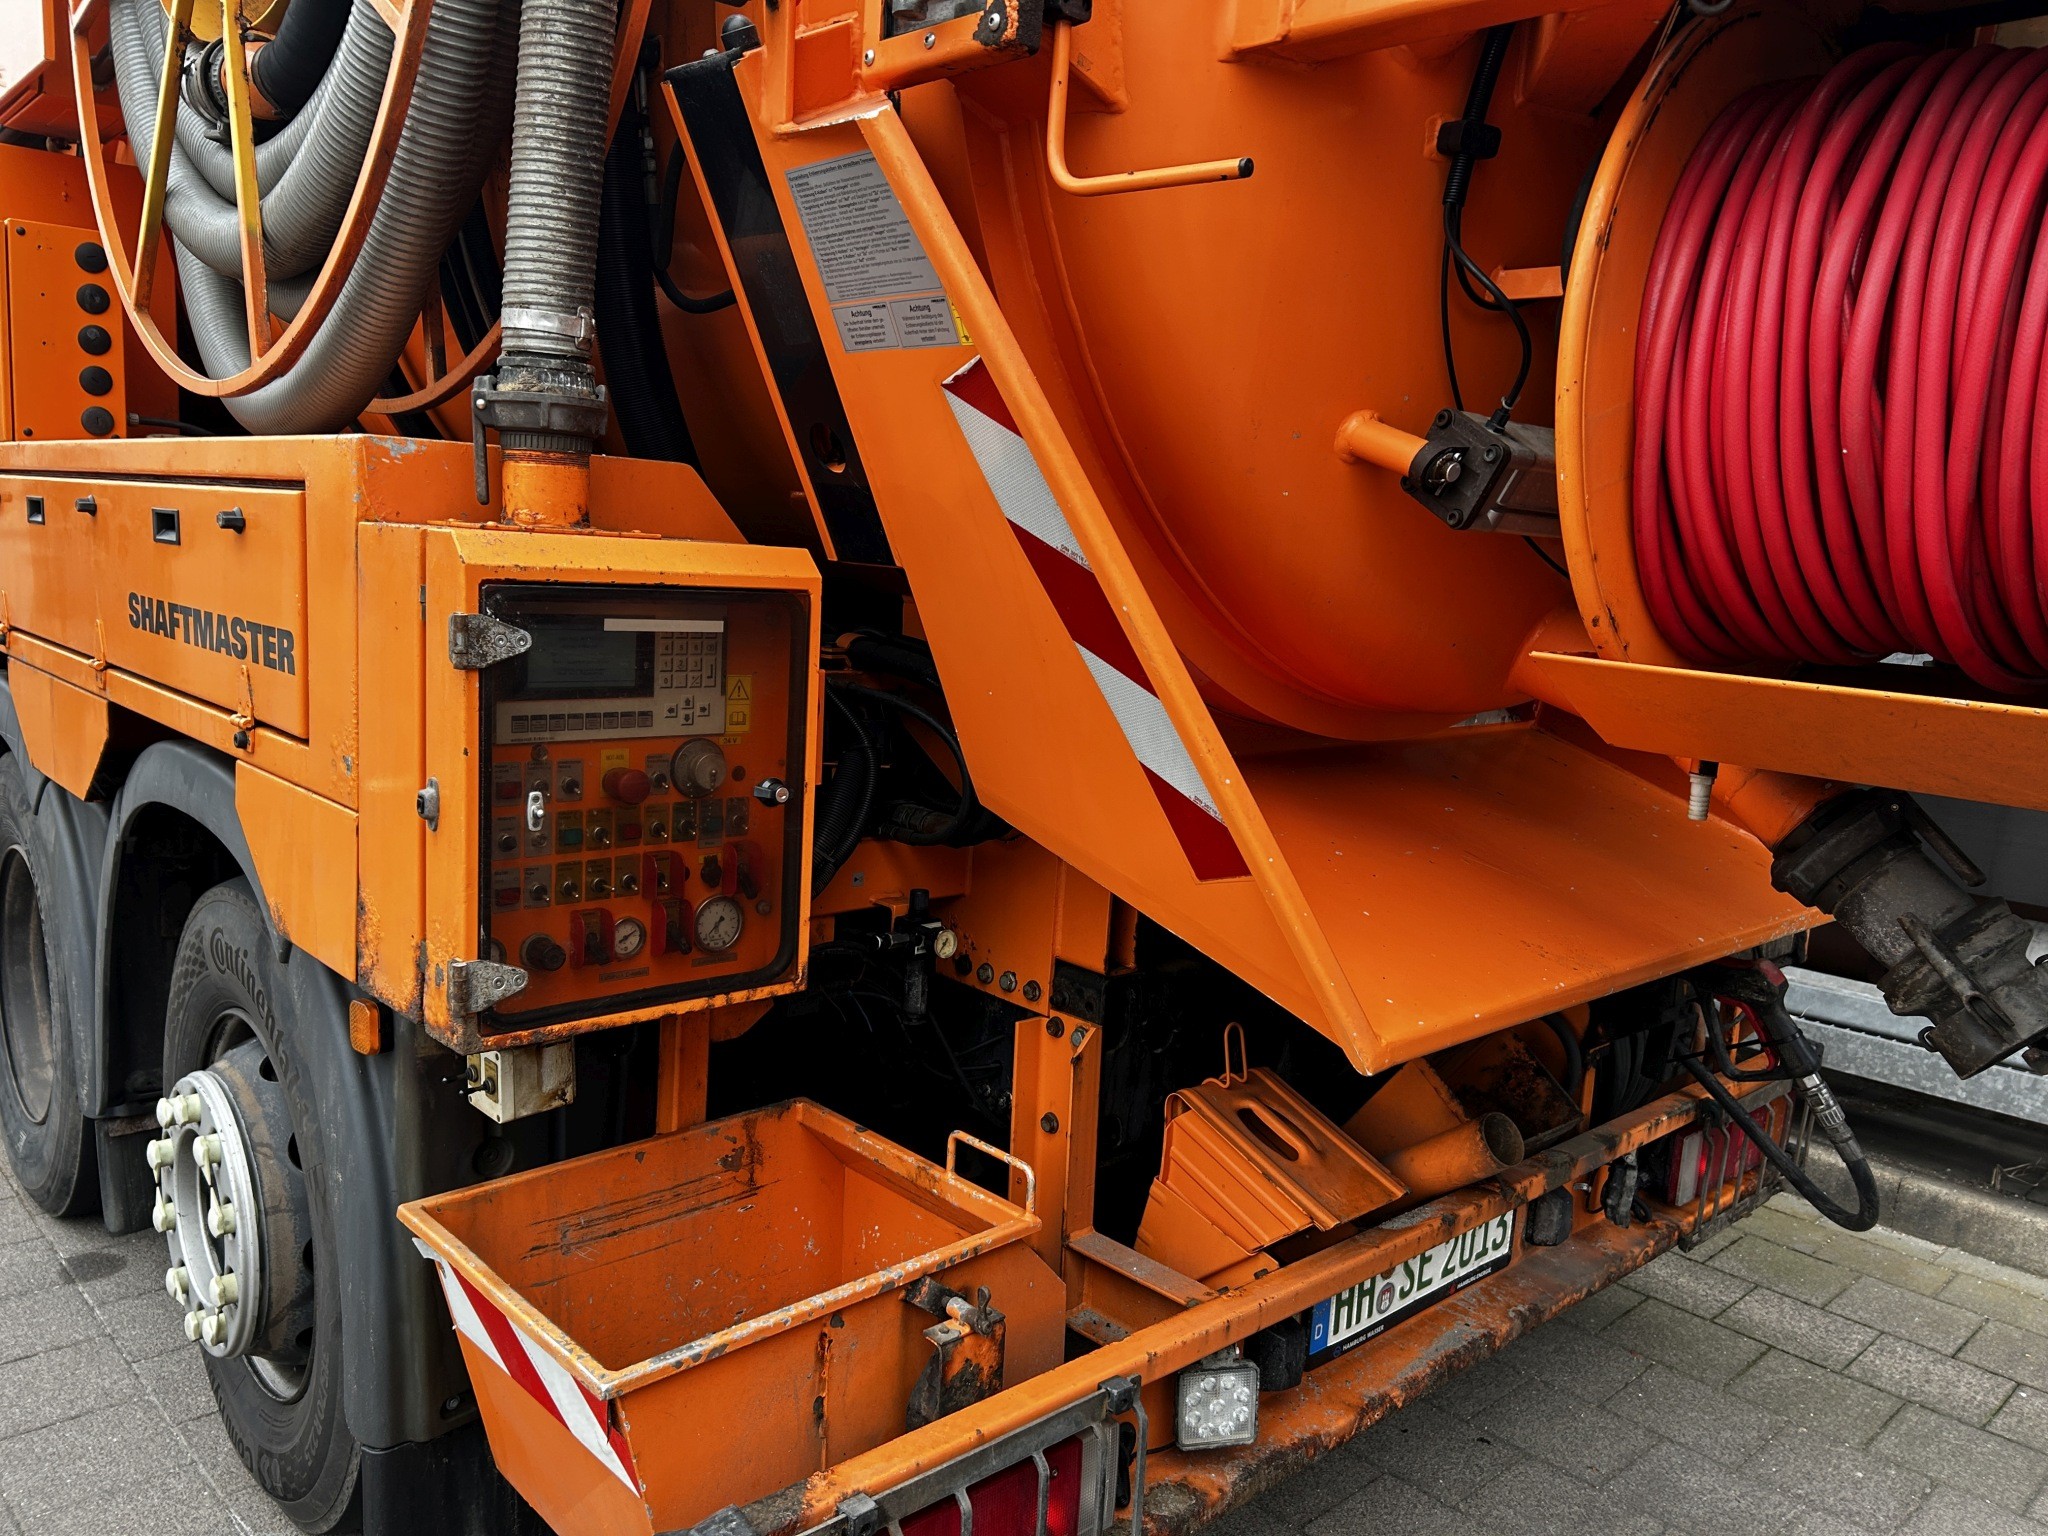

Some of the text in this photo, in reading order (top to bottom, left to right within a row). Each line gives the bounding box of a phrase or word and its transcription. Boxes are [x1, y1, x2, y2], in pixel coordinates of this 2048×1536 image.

[850, 309, 872, 318] Achtung
[909, 304, 931, 313] Achtung
[128, 591, 296, 676] SHAFTMASTER
[1332, 1213, 1508, 1336] HH SE 2013
[1314, 1323, 1323, 1340] D
[1342, 1324, 1385, 1351] HAMBURG WASSER
